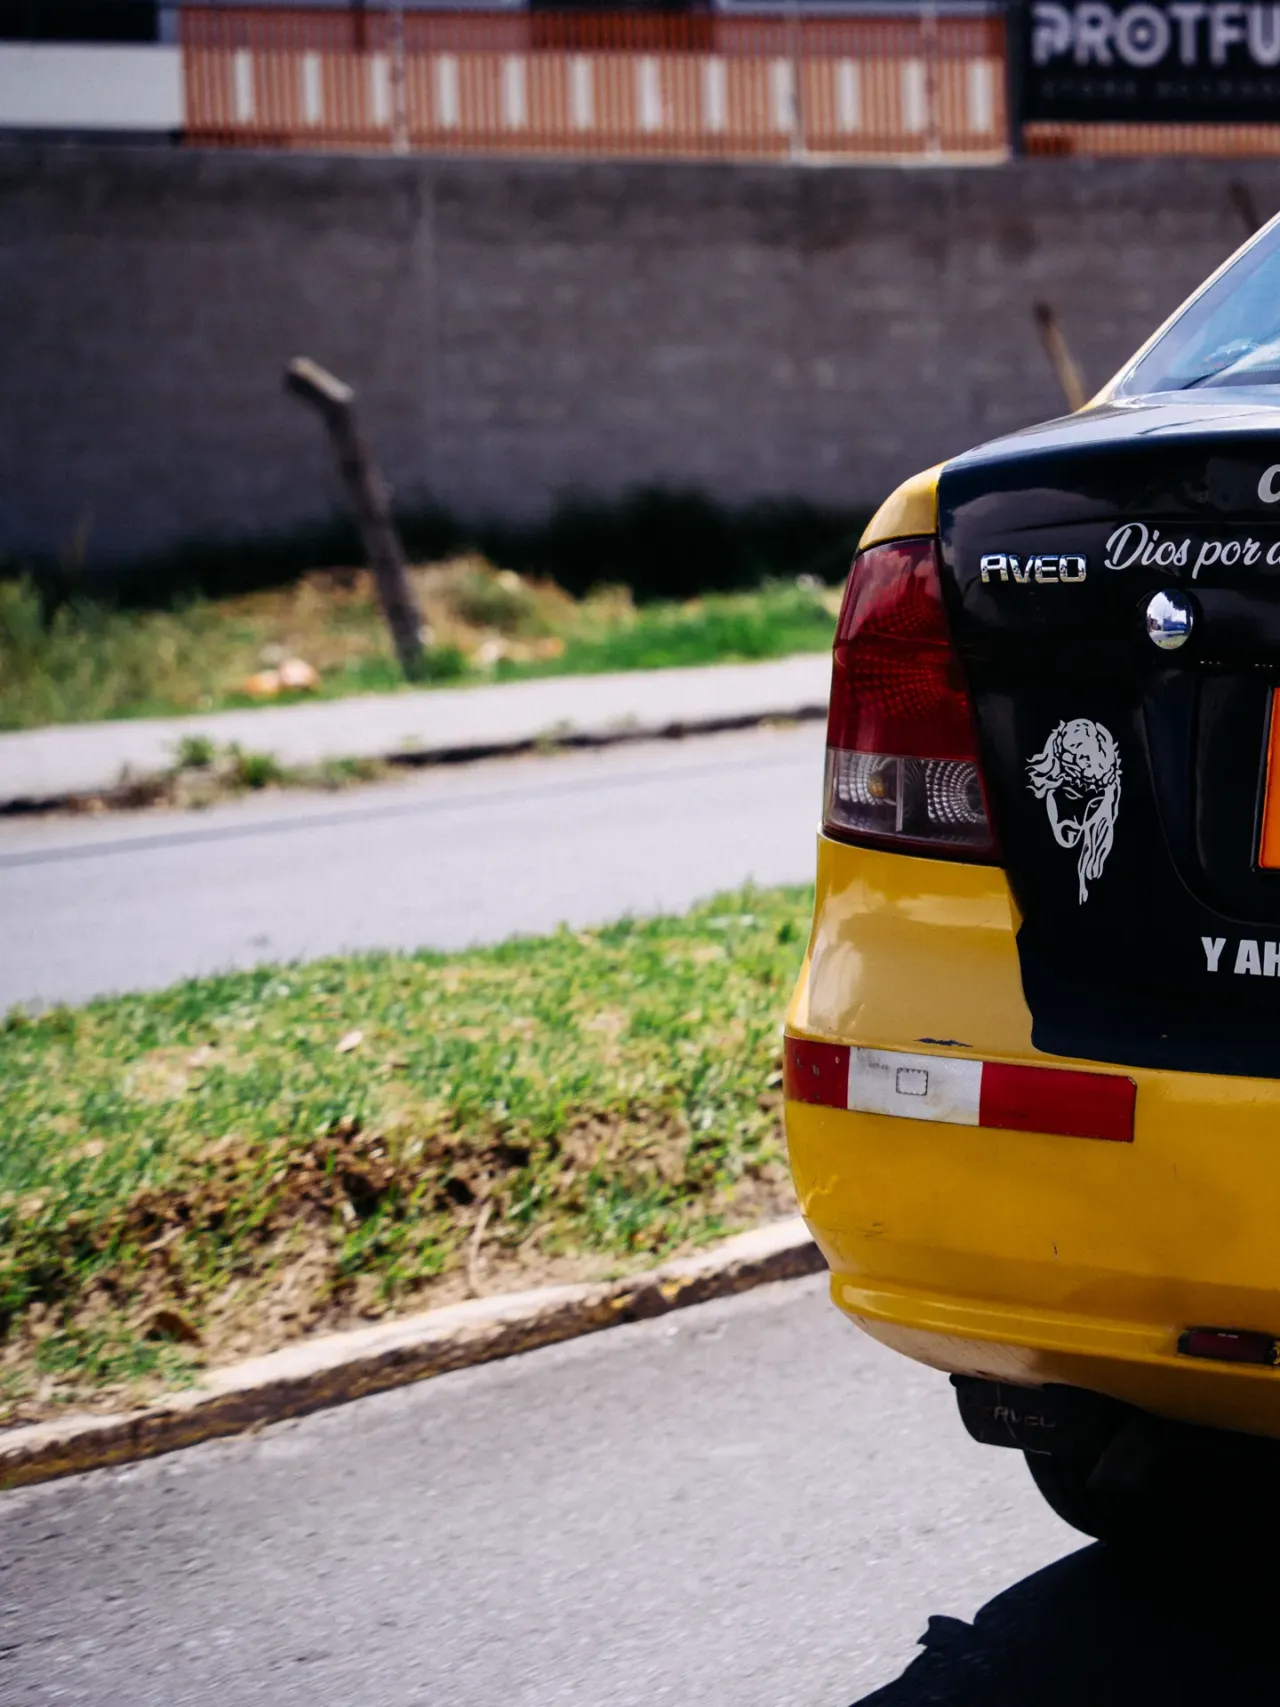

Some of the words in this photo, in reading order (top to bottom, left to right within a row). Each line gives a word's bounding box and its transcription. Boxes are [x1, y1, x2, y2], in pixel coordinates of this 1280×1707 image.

[979, 553, 1087, 584] AVEO
[1103, 522, 1191, 571] Dios
[1192, 541, 1263, 580] por
[1201, 936, 1227, 972] Y
